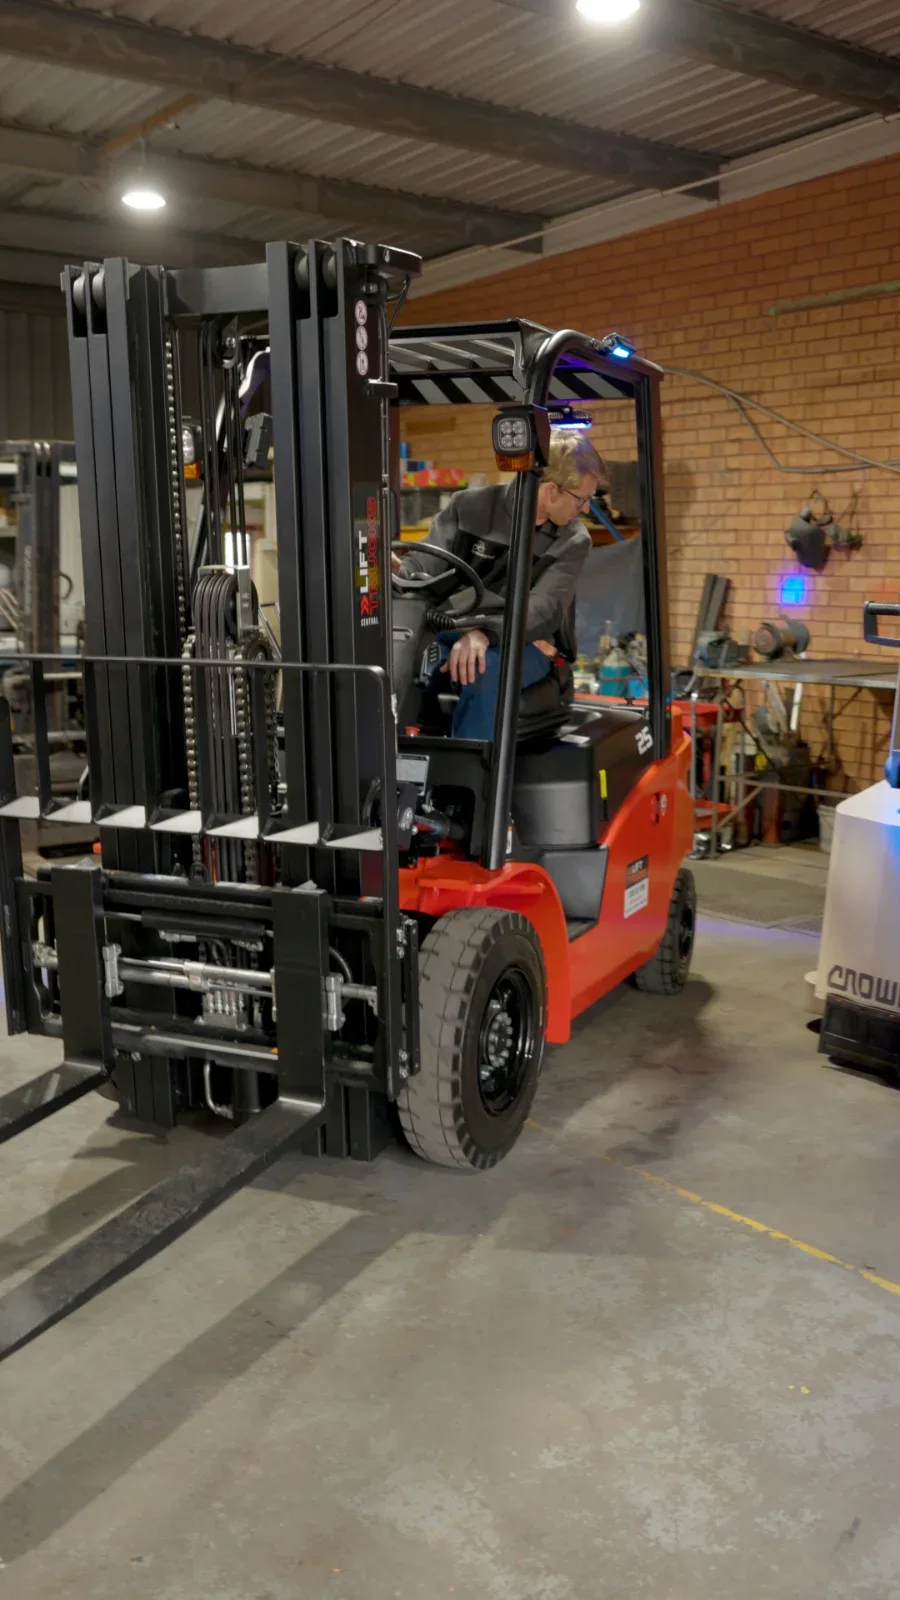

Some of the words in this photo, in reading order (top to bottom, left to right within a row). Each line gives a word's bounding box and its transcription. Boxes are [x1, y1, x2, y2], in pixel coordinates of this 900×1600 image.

[359, 530, 369, 593] LIFT
[367, 497, 379, 616] TRUCKS
[635, 726, 653, 755] 25
[828, 964, 900, 1008] CROW
